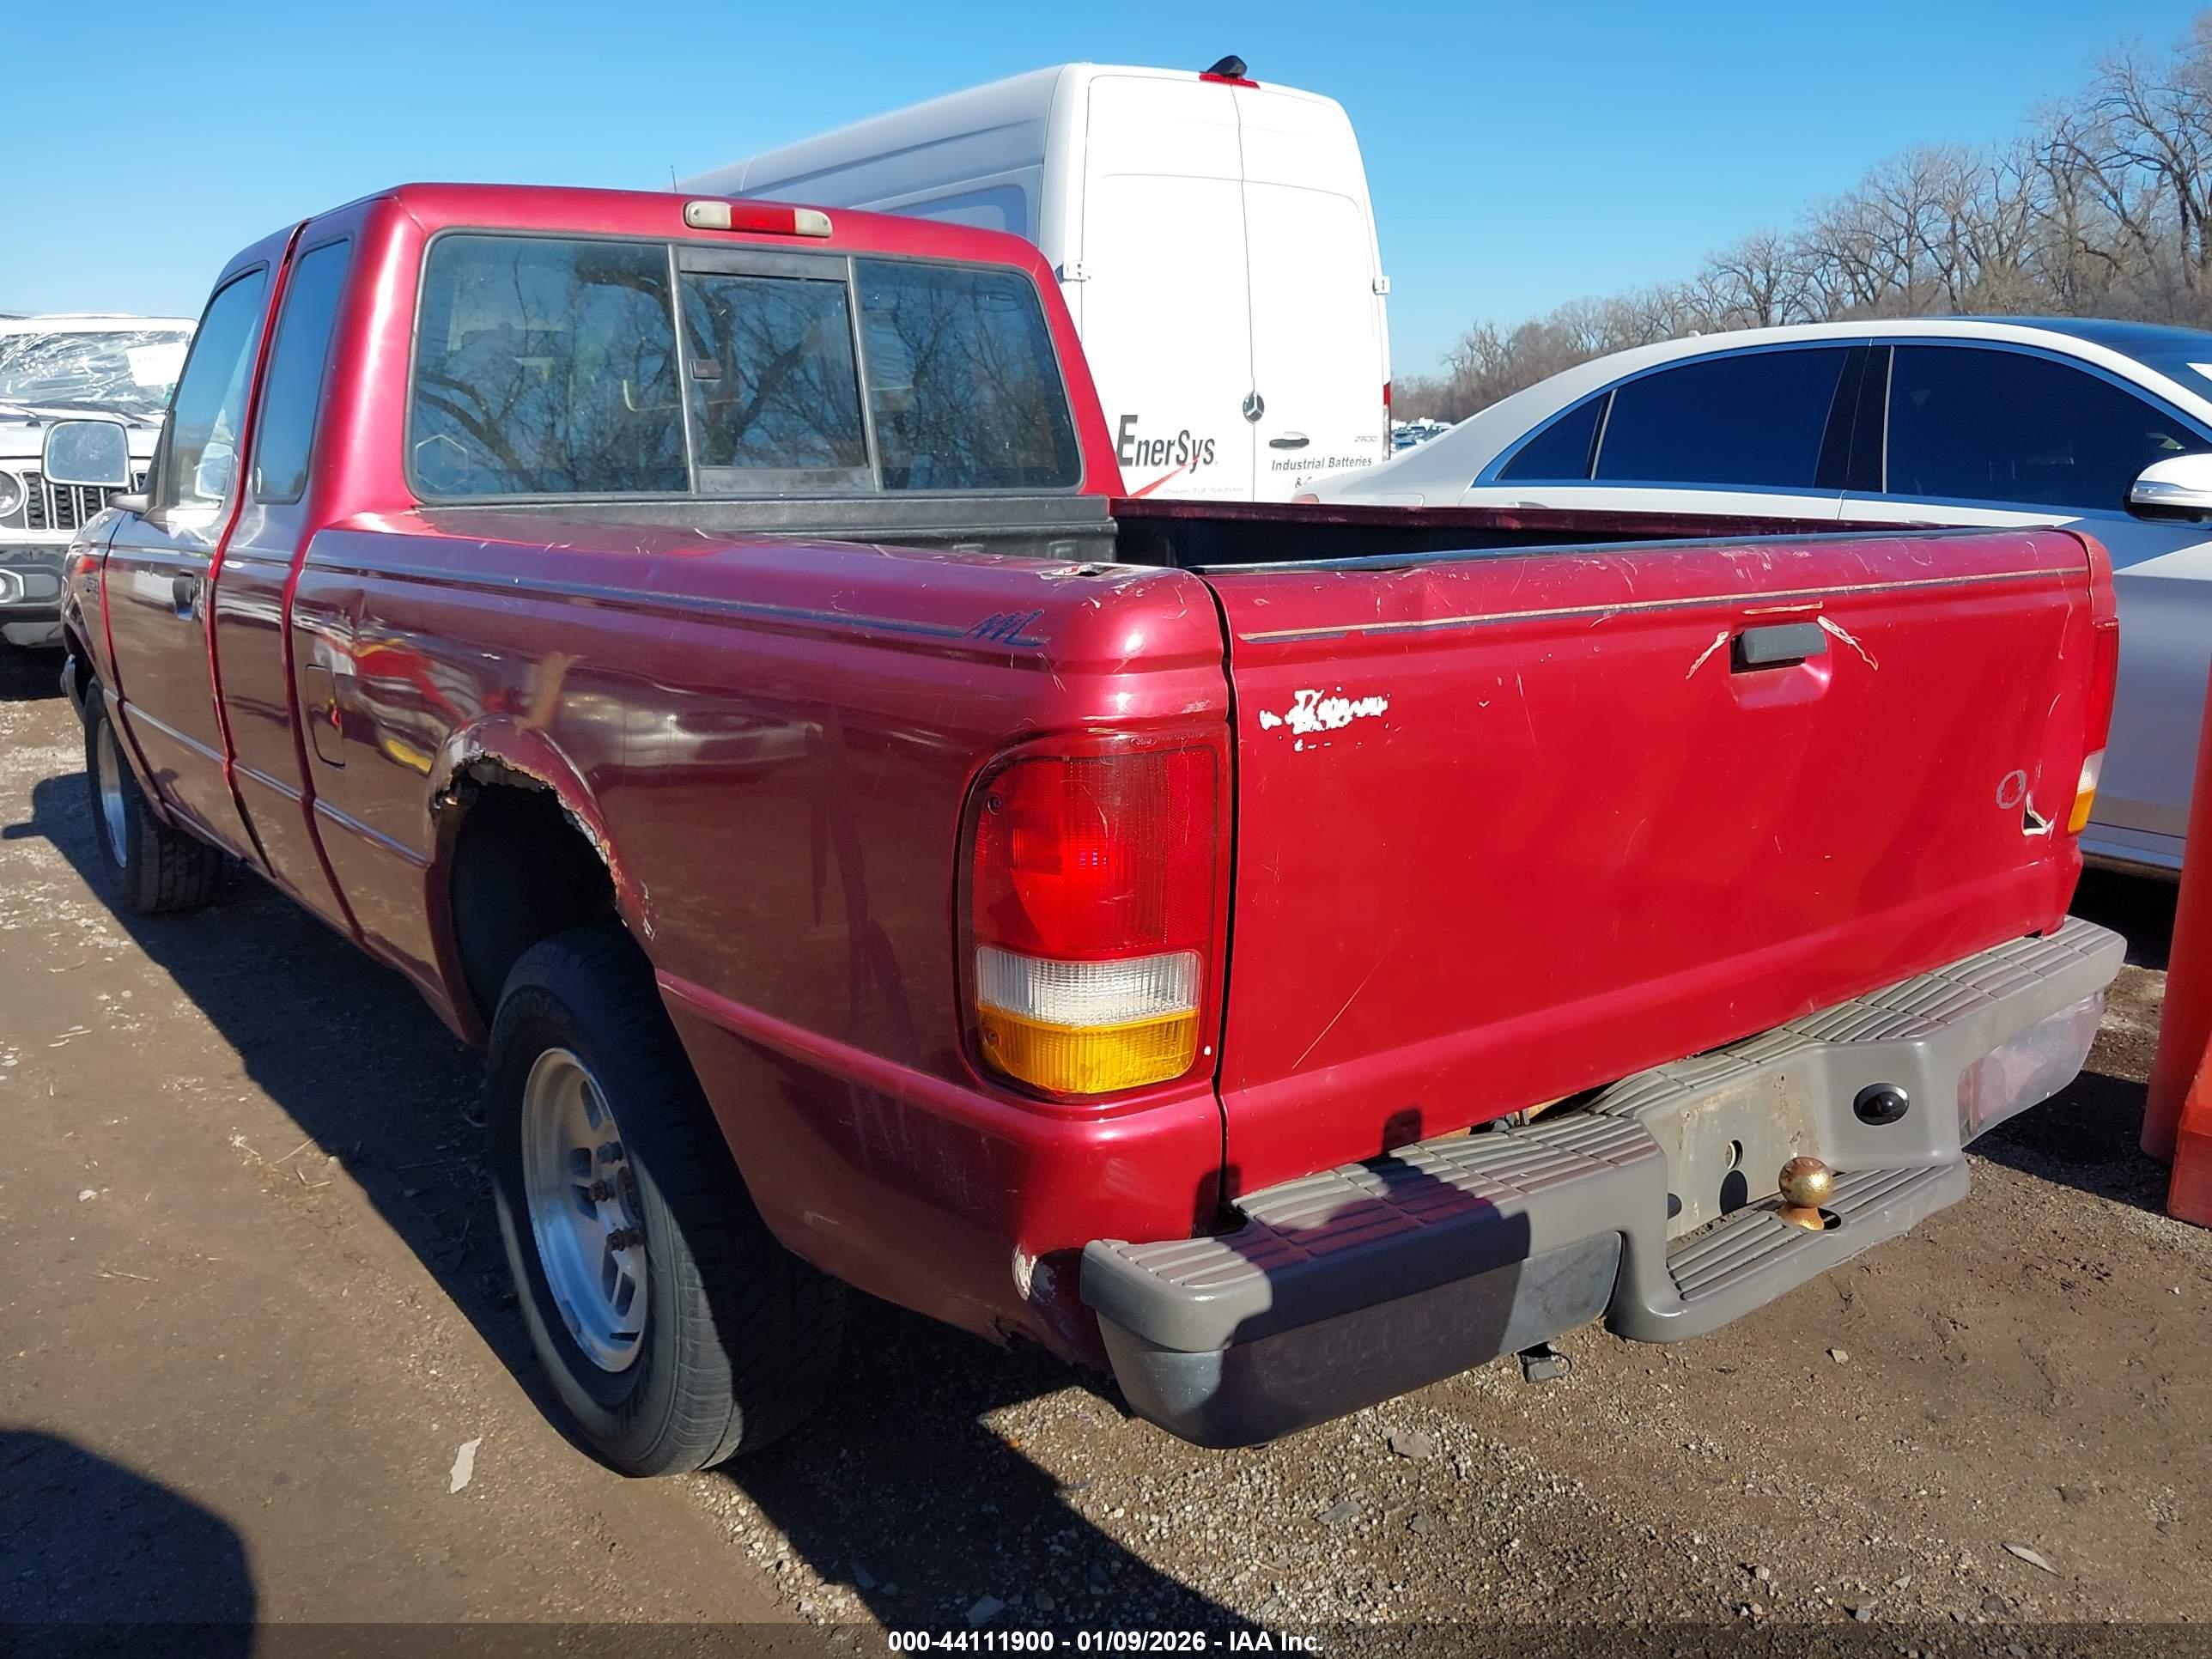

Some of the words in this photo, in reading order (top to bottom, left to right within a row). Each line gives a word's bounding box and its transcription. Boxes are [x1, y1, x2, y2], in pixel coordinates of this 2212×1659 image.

[1116, 414, 1216, 474] EnerSys
[1271, 459, 1325, 471] Industrial
[1328, 456, 1372, 468] Batteries
